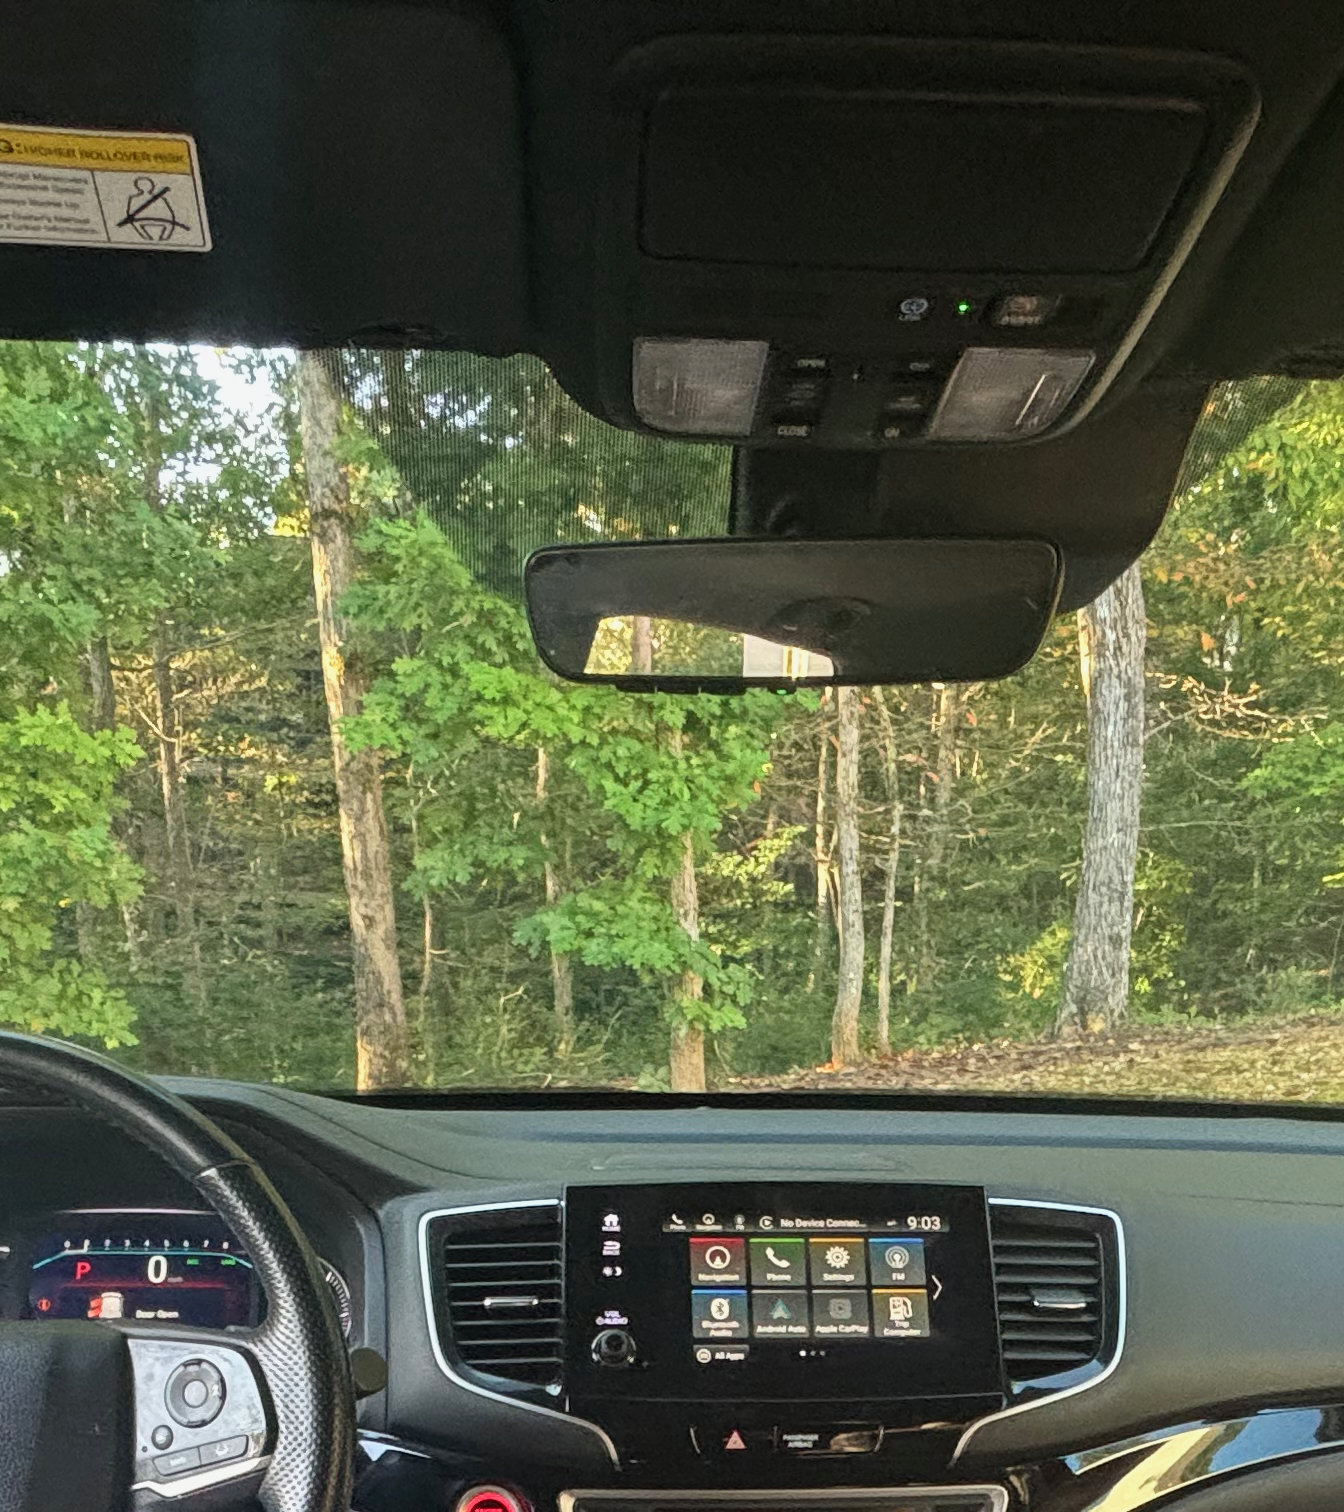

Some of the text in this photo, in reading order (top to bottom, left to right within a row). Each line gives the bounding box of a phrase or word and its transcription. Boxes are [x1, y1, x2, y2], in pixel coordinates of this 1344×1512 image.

[906, 1215, 942, 1231] 9:03
[75, 1254, 168, 1284] P 0
